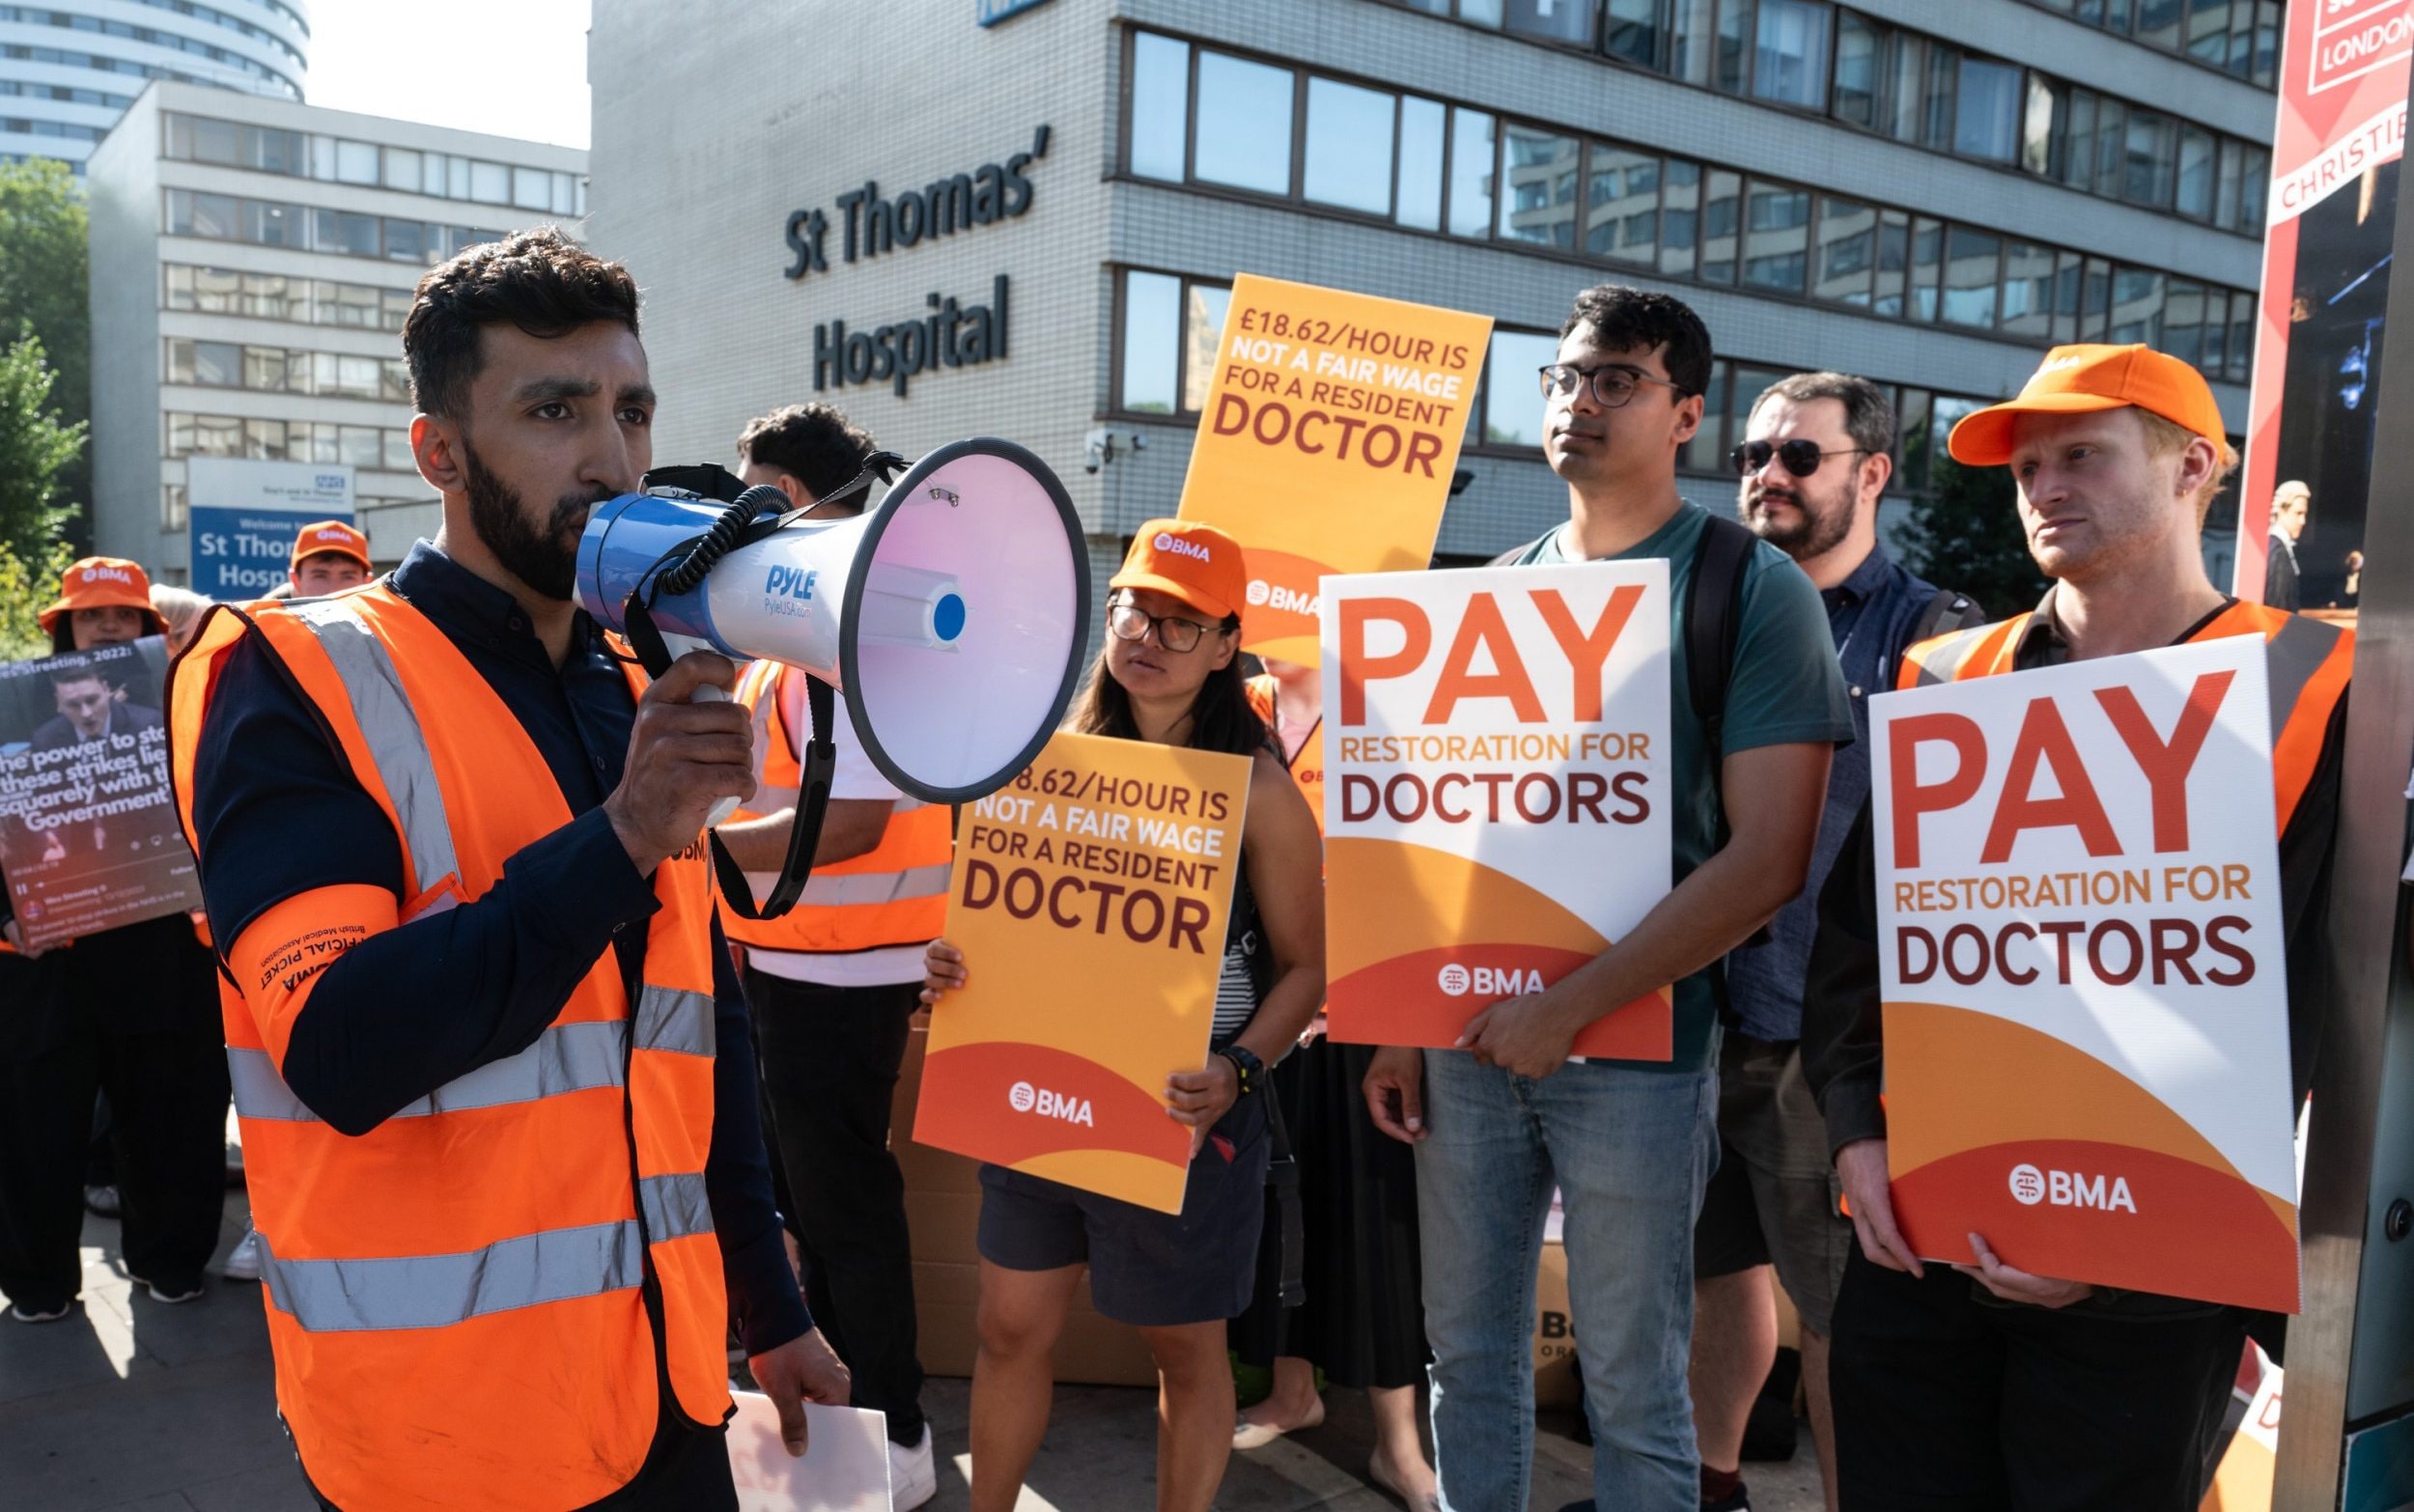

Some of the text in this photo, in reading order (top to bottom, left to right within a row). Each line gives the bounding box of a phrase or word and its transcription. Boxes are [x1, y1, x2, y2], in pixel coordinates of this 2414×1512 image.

[2322, 13, 2414, 72] LONDON
[784, 124, 1052, 280] St Thomas'
[813, 273, 1009, 397] Hospital
[1240, 307, 1470, 370] £18.62/HOUR IS
[1230, 335, 1463, 401] NOT A FAIR WAGE
[1224, 365, 1454, 428] FOR A RESIDENT
[1213, 393, 1443, 480] DOCTOR
[200, 533, 228, 557] St
[1170, 538, 1210, 563] BMA
[98, 567, 132, 586] BMA
[766, 565, 818, 600] PYLE
[1269, 585, 1320, 618] BMA
[1338, 584, 1647, 727] PAY
[1, 770, 62, 795] these
[66, 753, 137, 781] strikes
[32, 739, 107, 771] power
[110, 733, 135, 750] to
[138, 725, 165, 743] sto
[1340, 732, 1650, 763] RESTORATION FOR
[1888, 669, 2237, 869] PAY
[0, 781, 97, 819] squarely
[99, 770, 152, 795] with
[1007, 766, 1229, 822] 8.62/HOUR IS
[1341, 770, 1651, 825] DOCTORS
[974, 795, 1224, 857] NOT A FAIR WAGE
[970, 825, 1219, 891] FOR A RESIDENT
[962, 858, 1211, 955] DOCTOR
[1895, 864, 2252, 912] RESTORATION FOR
[260, 938, 364, 991] FICIAL PICKET
[262, 925, 365, 967] British Medical Association
[1896, 914, 2257, 987] DOCTORS
[1474, 966, 1545, 996] BMA
[1035, 1088, 1094, 1128] BMA
[2048, 1169, 2137, 1215] BMA
